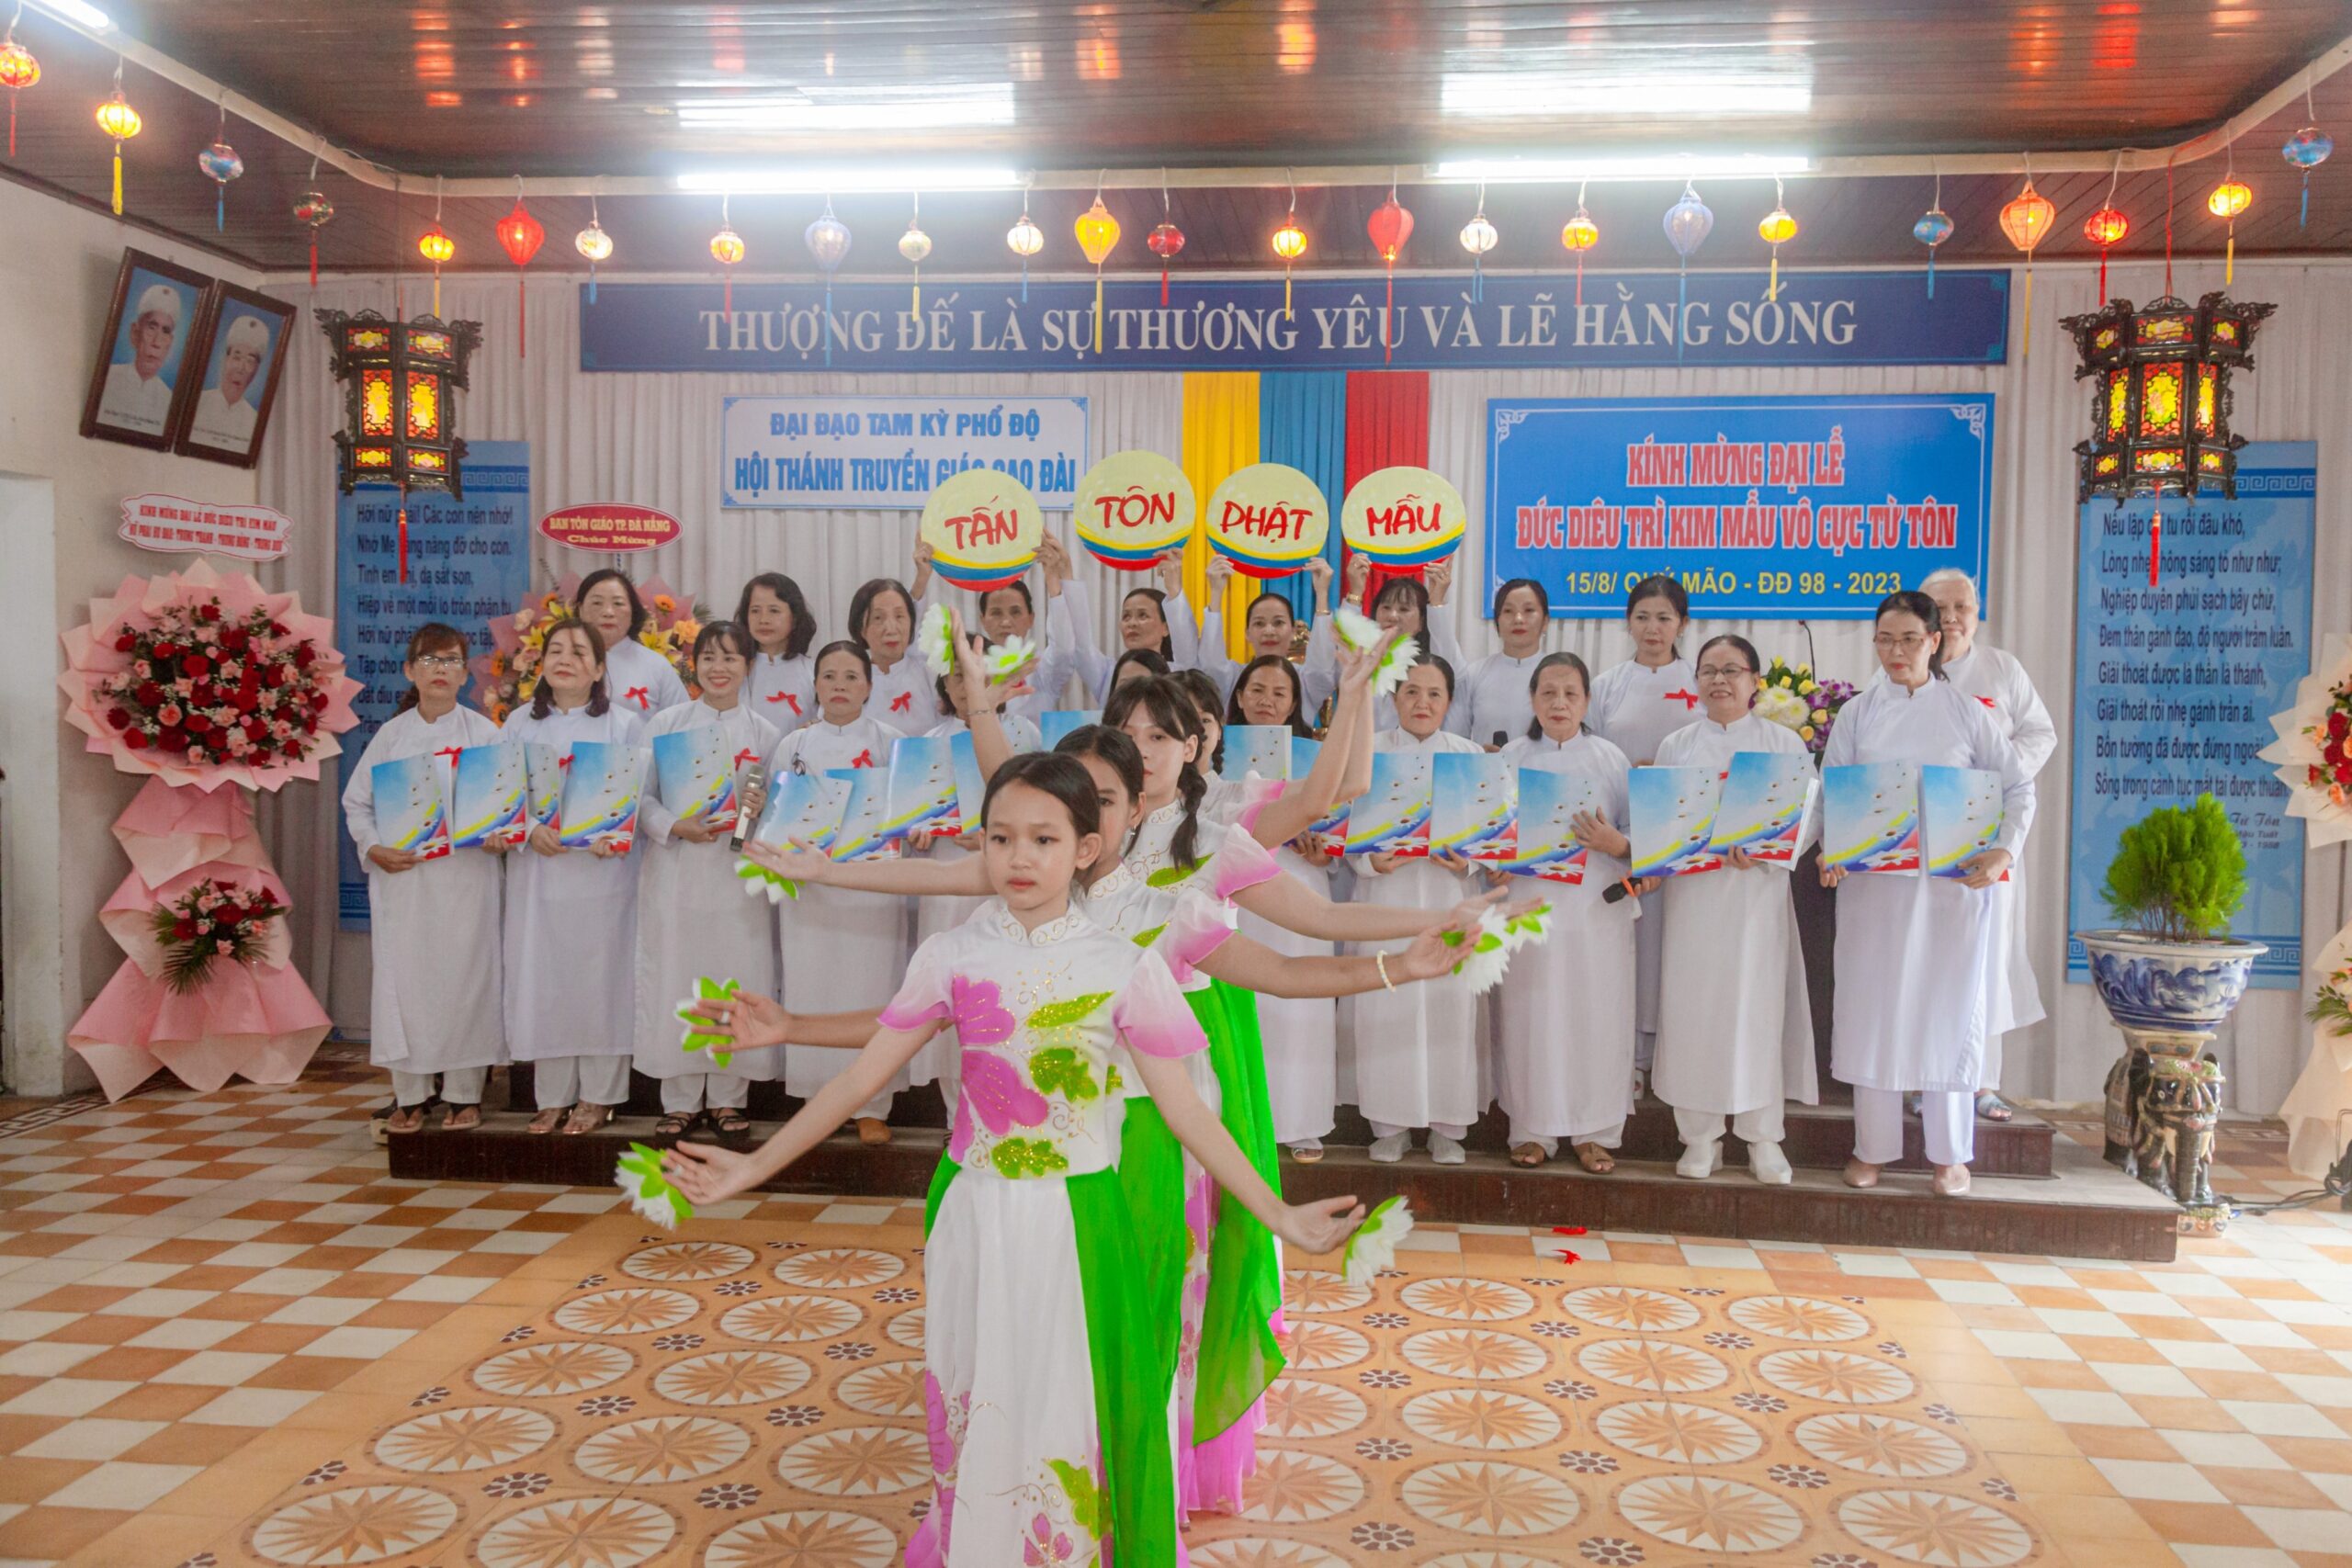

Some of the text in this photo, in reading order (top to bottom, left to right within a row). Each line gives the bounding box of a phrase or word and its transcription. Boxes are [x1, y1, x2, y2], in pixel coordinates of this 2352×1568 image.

[699, 281, 1858, 360] THƯỢNG ĐẾ LÀ SỰ THƯƠNG YÊU VÀ LẼ HẰNG SỐNG
[770, 403, 1040, 442] ĐẠI ĐẠO TAM KỲ PHỔ ĐỘ
[735, 450, 770, 499] HỘI
[775, 450, 844, 491] THÁNH
[1039, 452, 1075, 492] ĐÀI
[1626, 432, 1688, 488] KÍNH
[1689, 431, 1764, 487] MỪNG
[1767, 442, 1811, 494] ĐẠI
[446, 510, 464, 524] con
[549, 517, 569, 530] BAN
[570, 515, 589, 531] TÔN
[590, 514, 613, 531] GIÁO
[628, 515, 643, 532] ĐÀ
[944, 495, 1018, 550] TẤN
[1094, 485, 1176, 529] TÔN
[1219, 500, 1314, 543] PHẬT
[1365, 493, 1442, 537] MẪU
[1516, 494, 1564, 549] ĐỨC
[1566, 496, 1622, 549] DIÊU
[1623, 493, 1667, 549] TRÌ
[1668, 504, 1717, 549] KIM
[1780, 495, 1813, 549] VÔ
[1816, 504, 1865, 558] CỰC
[1866, 493, 1904, 549] TỪ
[1905, 494, 1959, 549] TÔN
[2167, 514, 2177, 536] tu
[469, 536, 488, 555] cho
[2102, 550, 2130, 580] Lòng
[2189, 549, 2216, 580] sáng
[1566, 571, 1618, 594] 15/8/
[1682, 567, 1736, 594] MÃO
[1757, 571, 1792, 594] ĐĐ
[1799, 571, 1826, 594] 98
[1847, 571, 1901, 594] 2023
[2099, 624, 2121, 647] Đem
